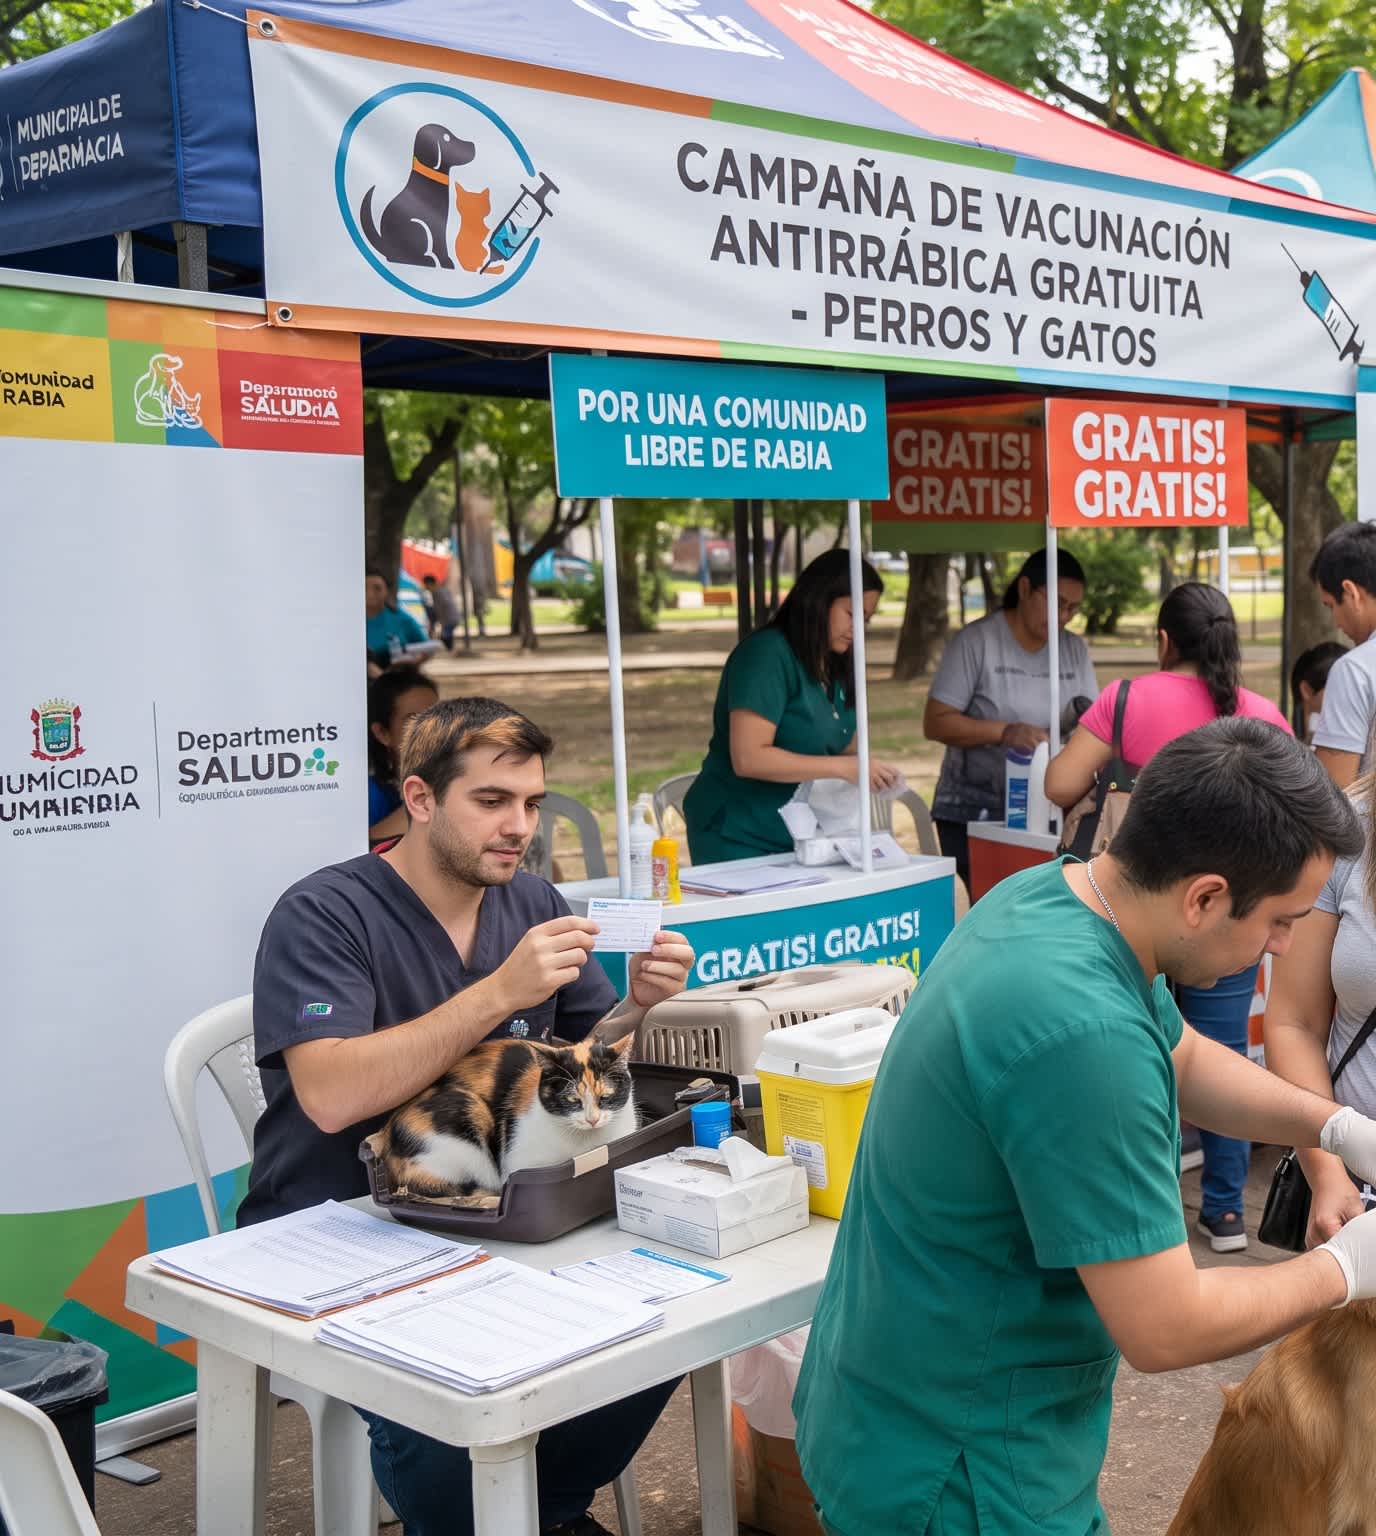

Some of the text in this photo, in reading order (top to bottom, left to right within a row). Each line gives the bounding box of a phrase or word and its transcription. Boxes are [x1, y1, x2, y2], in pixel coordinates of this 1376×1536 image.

[676, 141, 1230, 270] CAMPAÑA DE VACUNACIÓN
[710, 214, 1204, 320] ANTIRRÁBICA GRATUITA
[824, 291, 991, 352] PERROS
[1003, 311, 1028, 355] Y
[1040, 316, 1157, 368] GATOS
[3, 388, 65, 408] RABIA
[578, 388, 867, 433] POR UNA COMUNIDAD
[624, 433, 833, 471] LIBRE DE RABIA
[893, 428, 1032, 471] GRATIS!
[1072, 410, 1227, 466] GRATIS!
[894, 475, 1033, 517] GRATIS!
[1074, 469, 1228, 519] GRATIS!
[177, 722, 338, 753] Departments
[178, 752, 302, 787] SALUD
[696, 931, 816, 983] GRATIS!
[824, 908, 921, 958] GRATIS!
